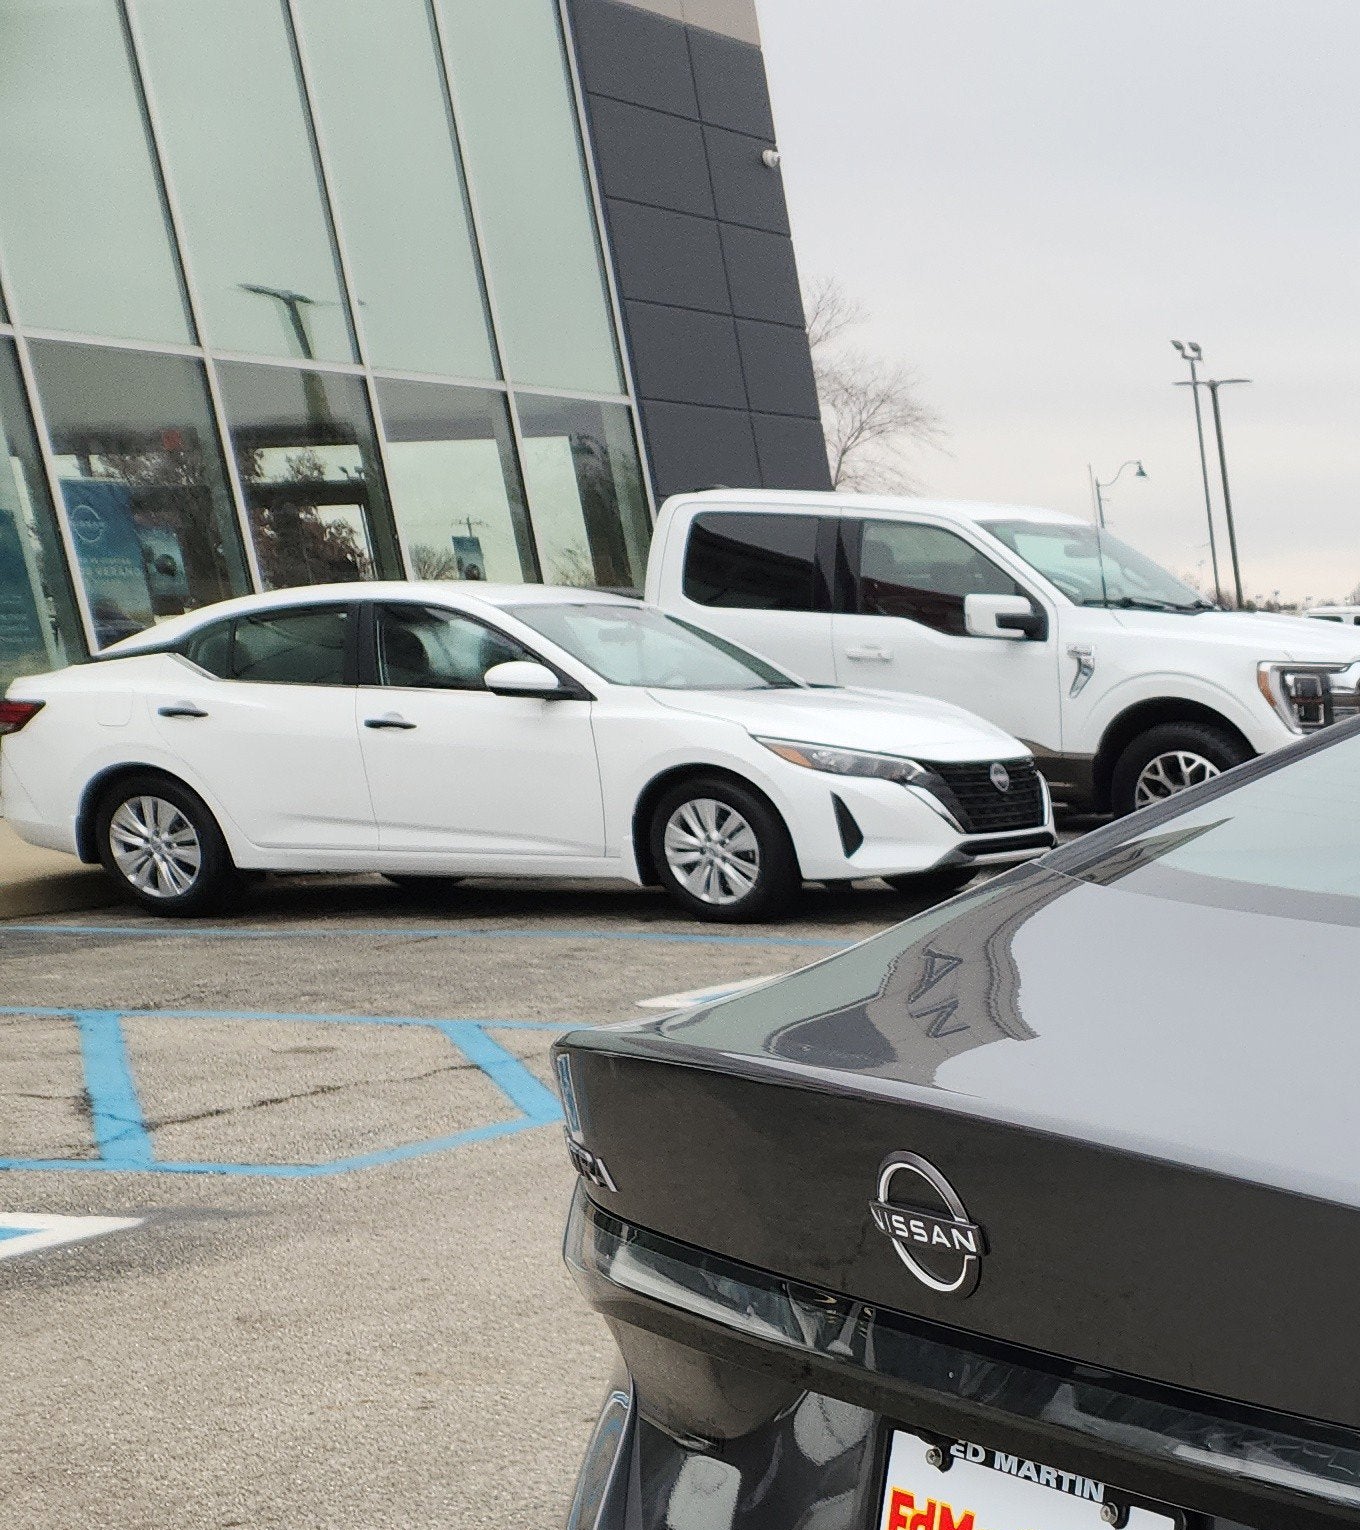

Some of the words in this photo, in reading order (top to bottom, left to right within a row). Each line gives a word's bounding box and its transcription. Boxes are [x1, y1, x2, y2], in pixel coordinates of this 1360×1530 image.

[870, 1205, 977, 1253] NISSAN
[949, 1440, 986, 1464] ED
[993, 1449, 1105, 1503] MARTIN
